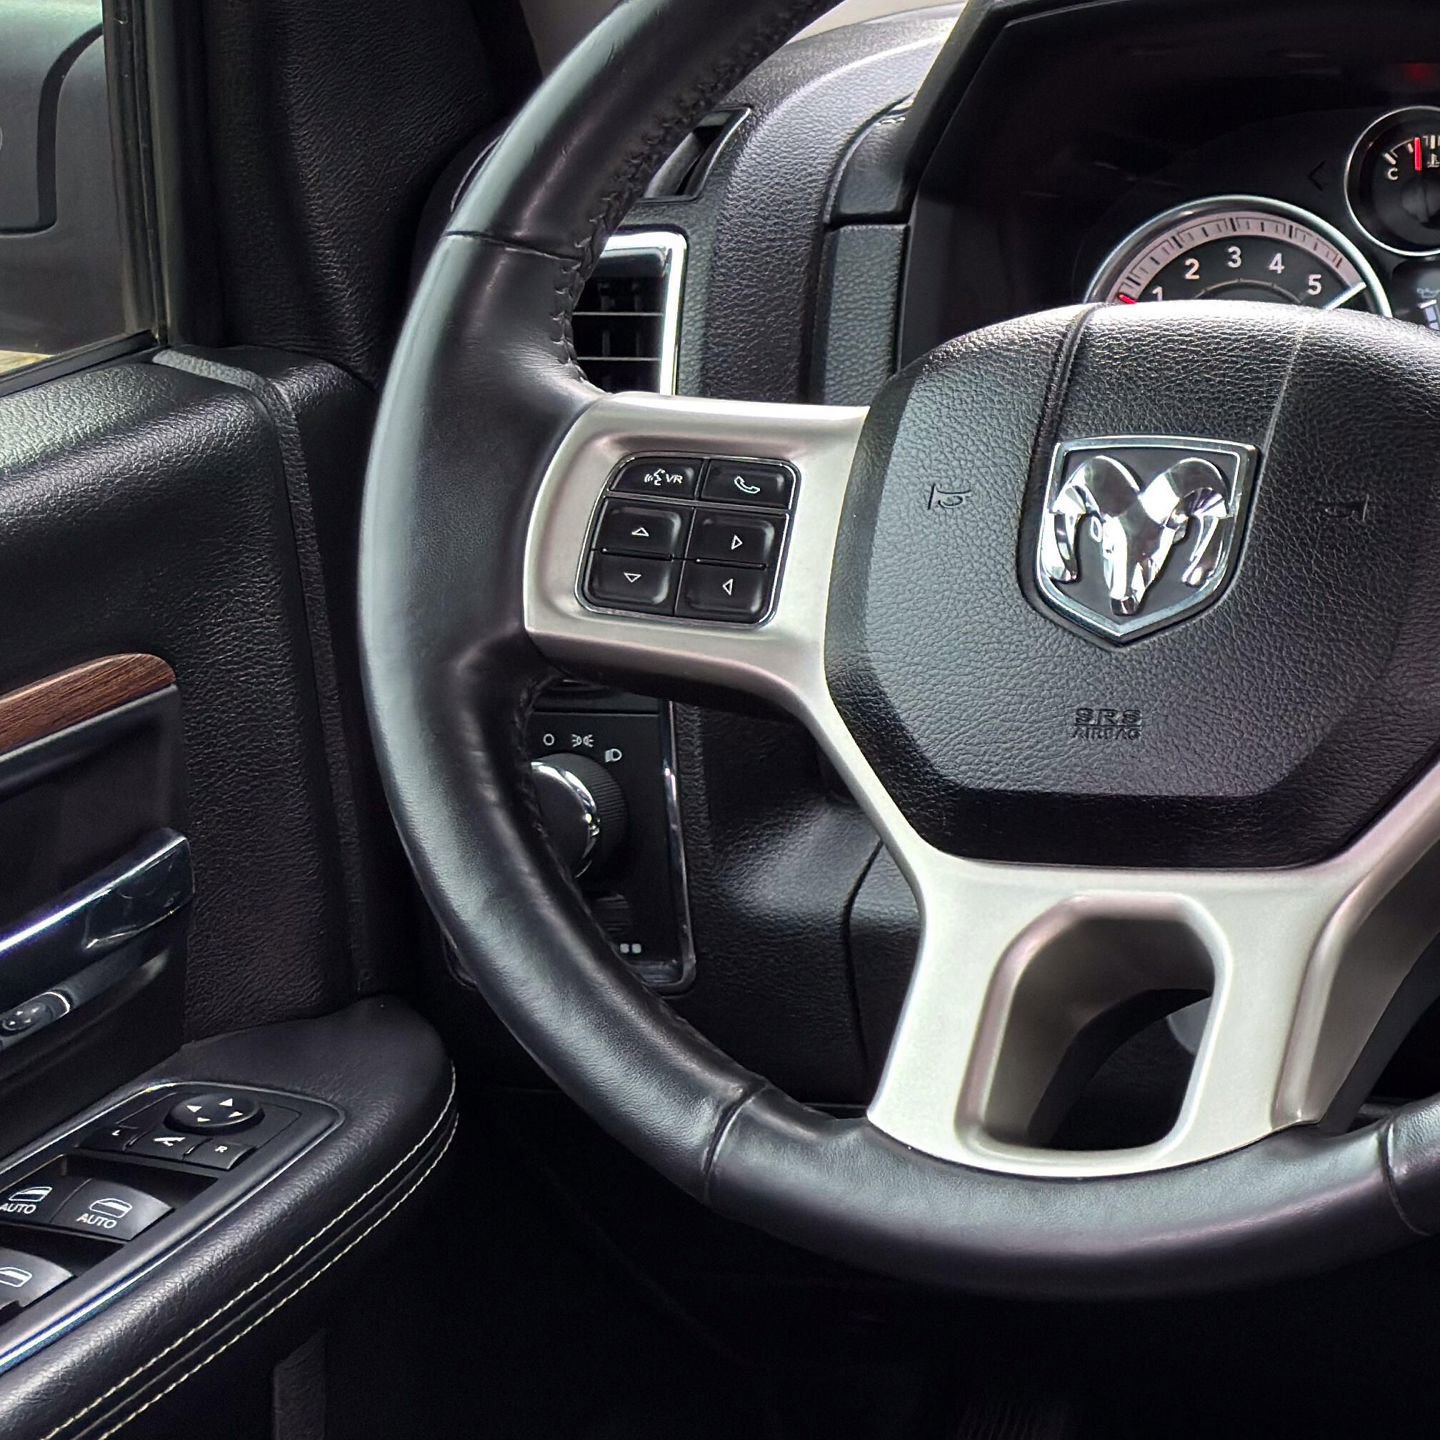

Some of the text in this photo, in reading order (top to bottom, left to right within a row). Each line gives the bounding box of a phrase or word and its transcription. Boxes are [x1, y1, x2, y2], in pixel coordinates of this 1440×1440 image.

[1386, 167, 1399, 181] C
[1226, 247, 1242, 269] 3
[1269, 253, 1285, 275] 4
[1184, 258, 1200, 280] 2
[1307, 273, 1323, 296] 5
[665, 474, 683, 484] VR
[0, 1202, 37, 1214] AUTO
[76, 1213, 117, 1229] AUTO
